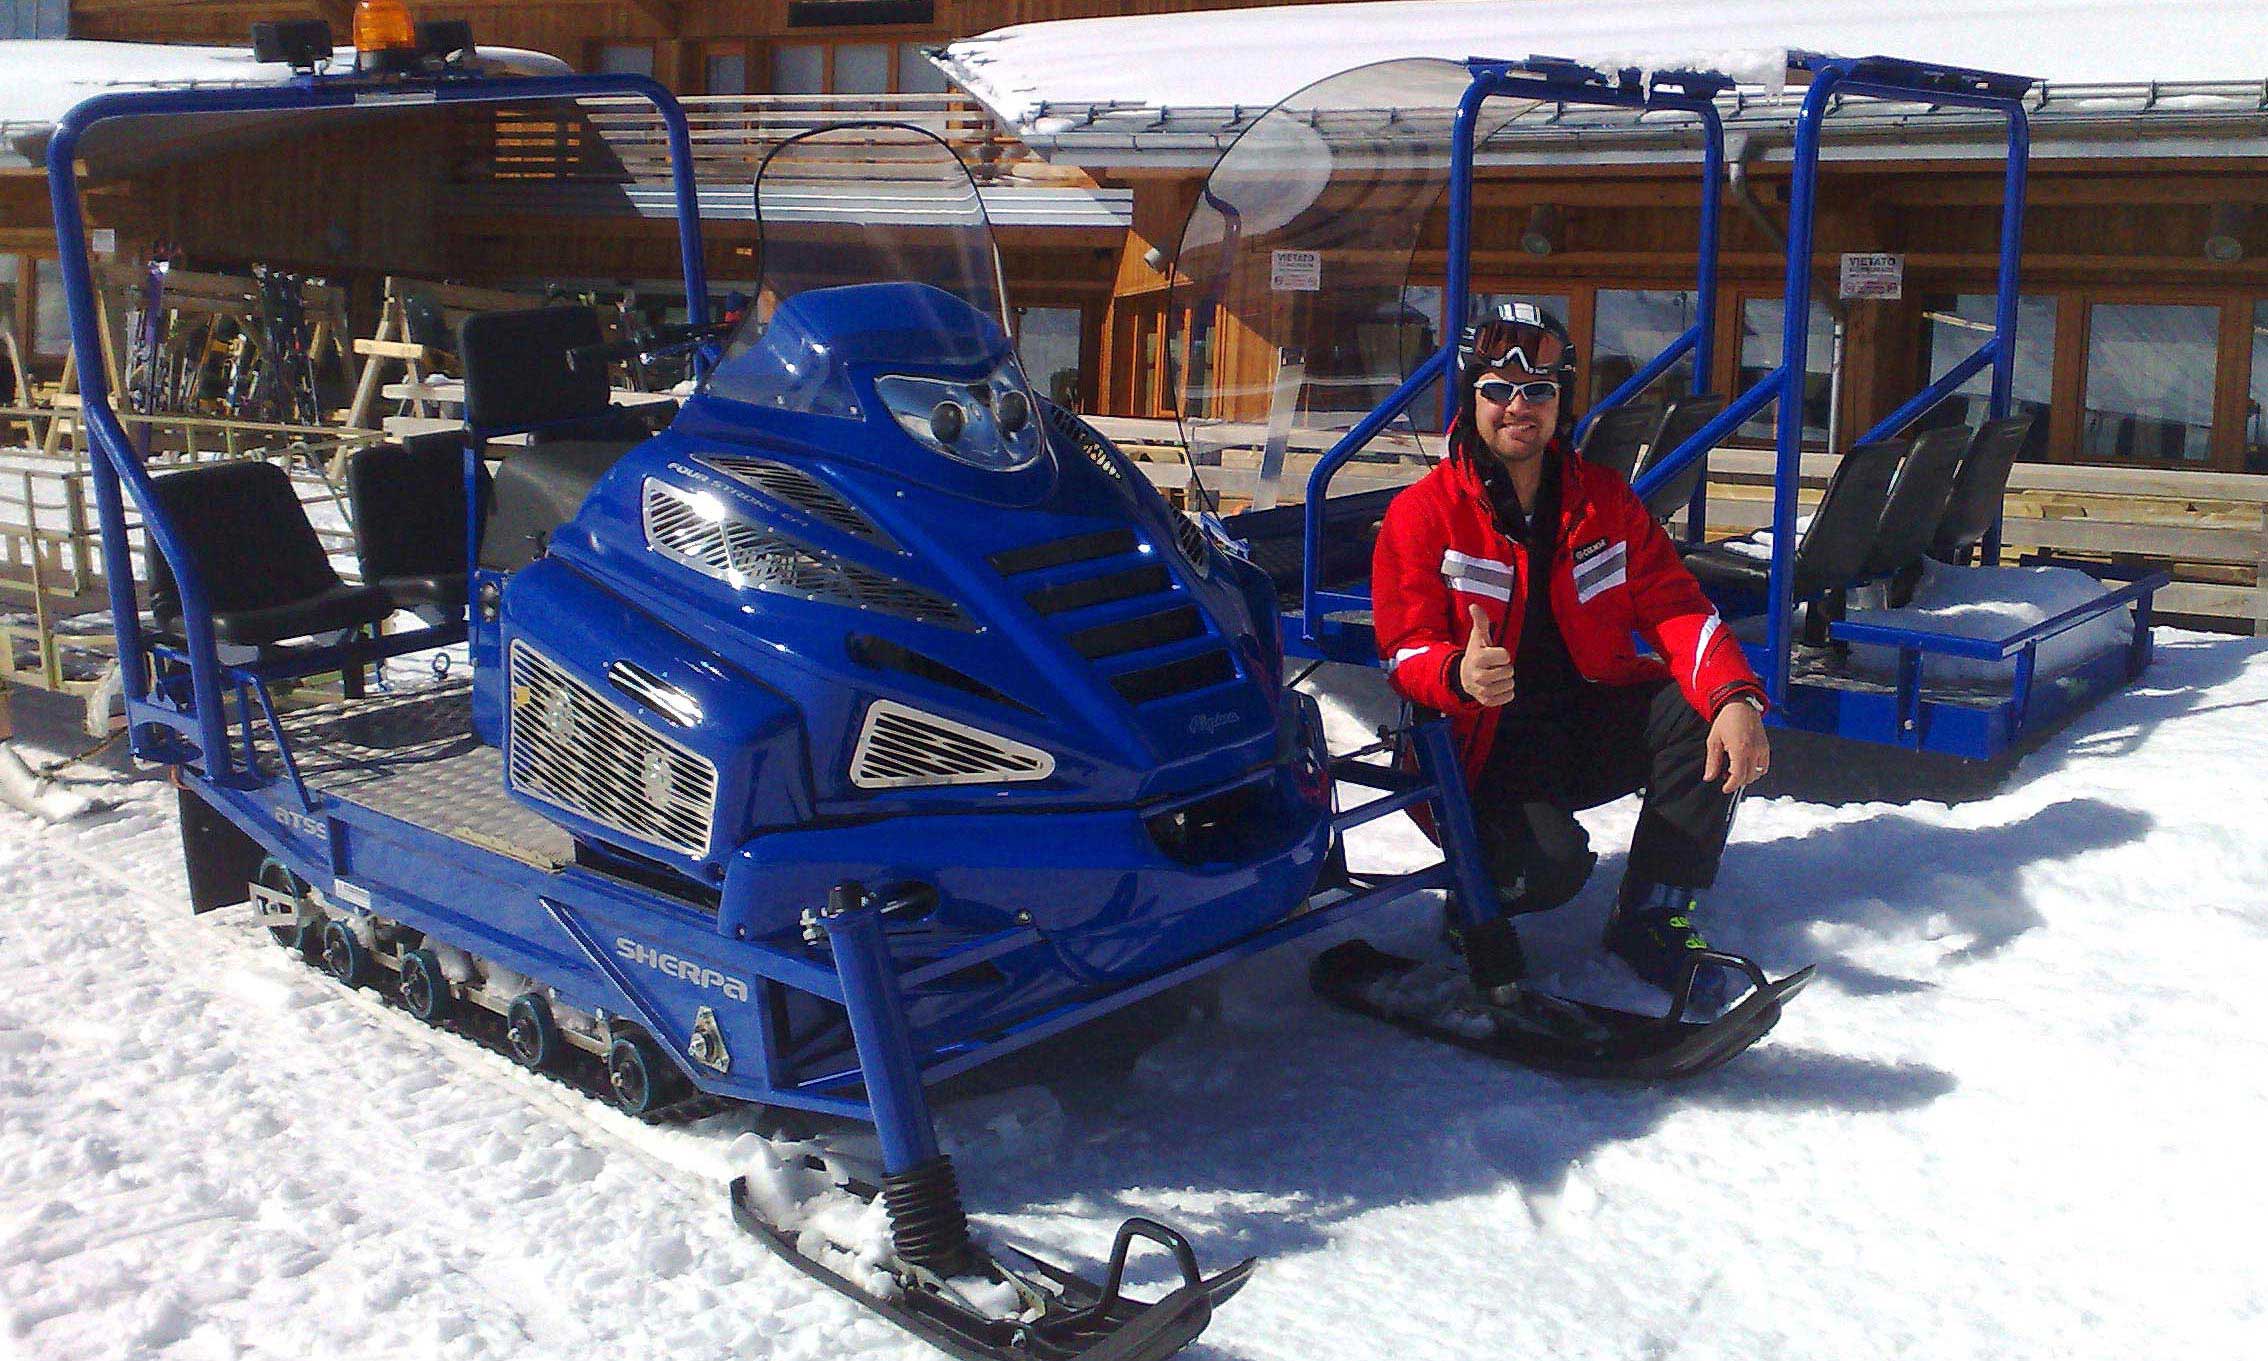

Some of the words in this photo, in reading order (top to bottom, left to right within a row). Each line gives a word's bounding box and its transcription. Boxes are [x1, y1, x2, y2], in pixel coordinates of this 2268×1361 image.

[1849, 256, 1896, 266] VIETATO
[667, 462, 710, 482] FOUR
[616, 937, 748, 1002] SHERPA
